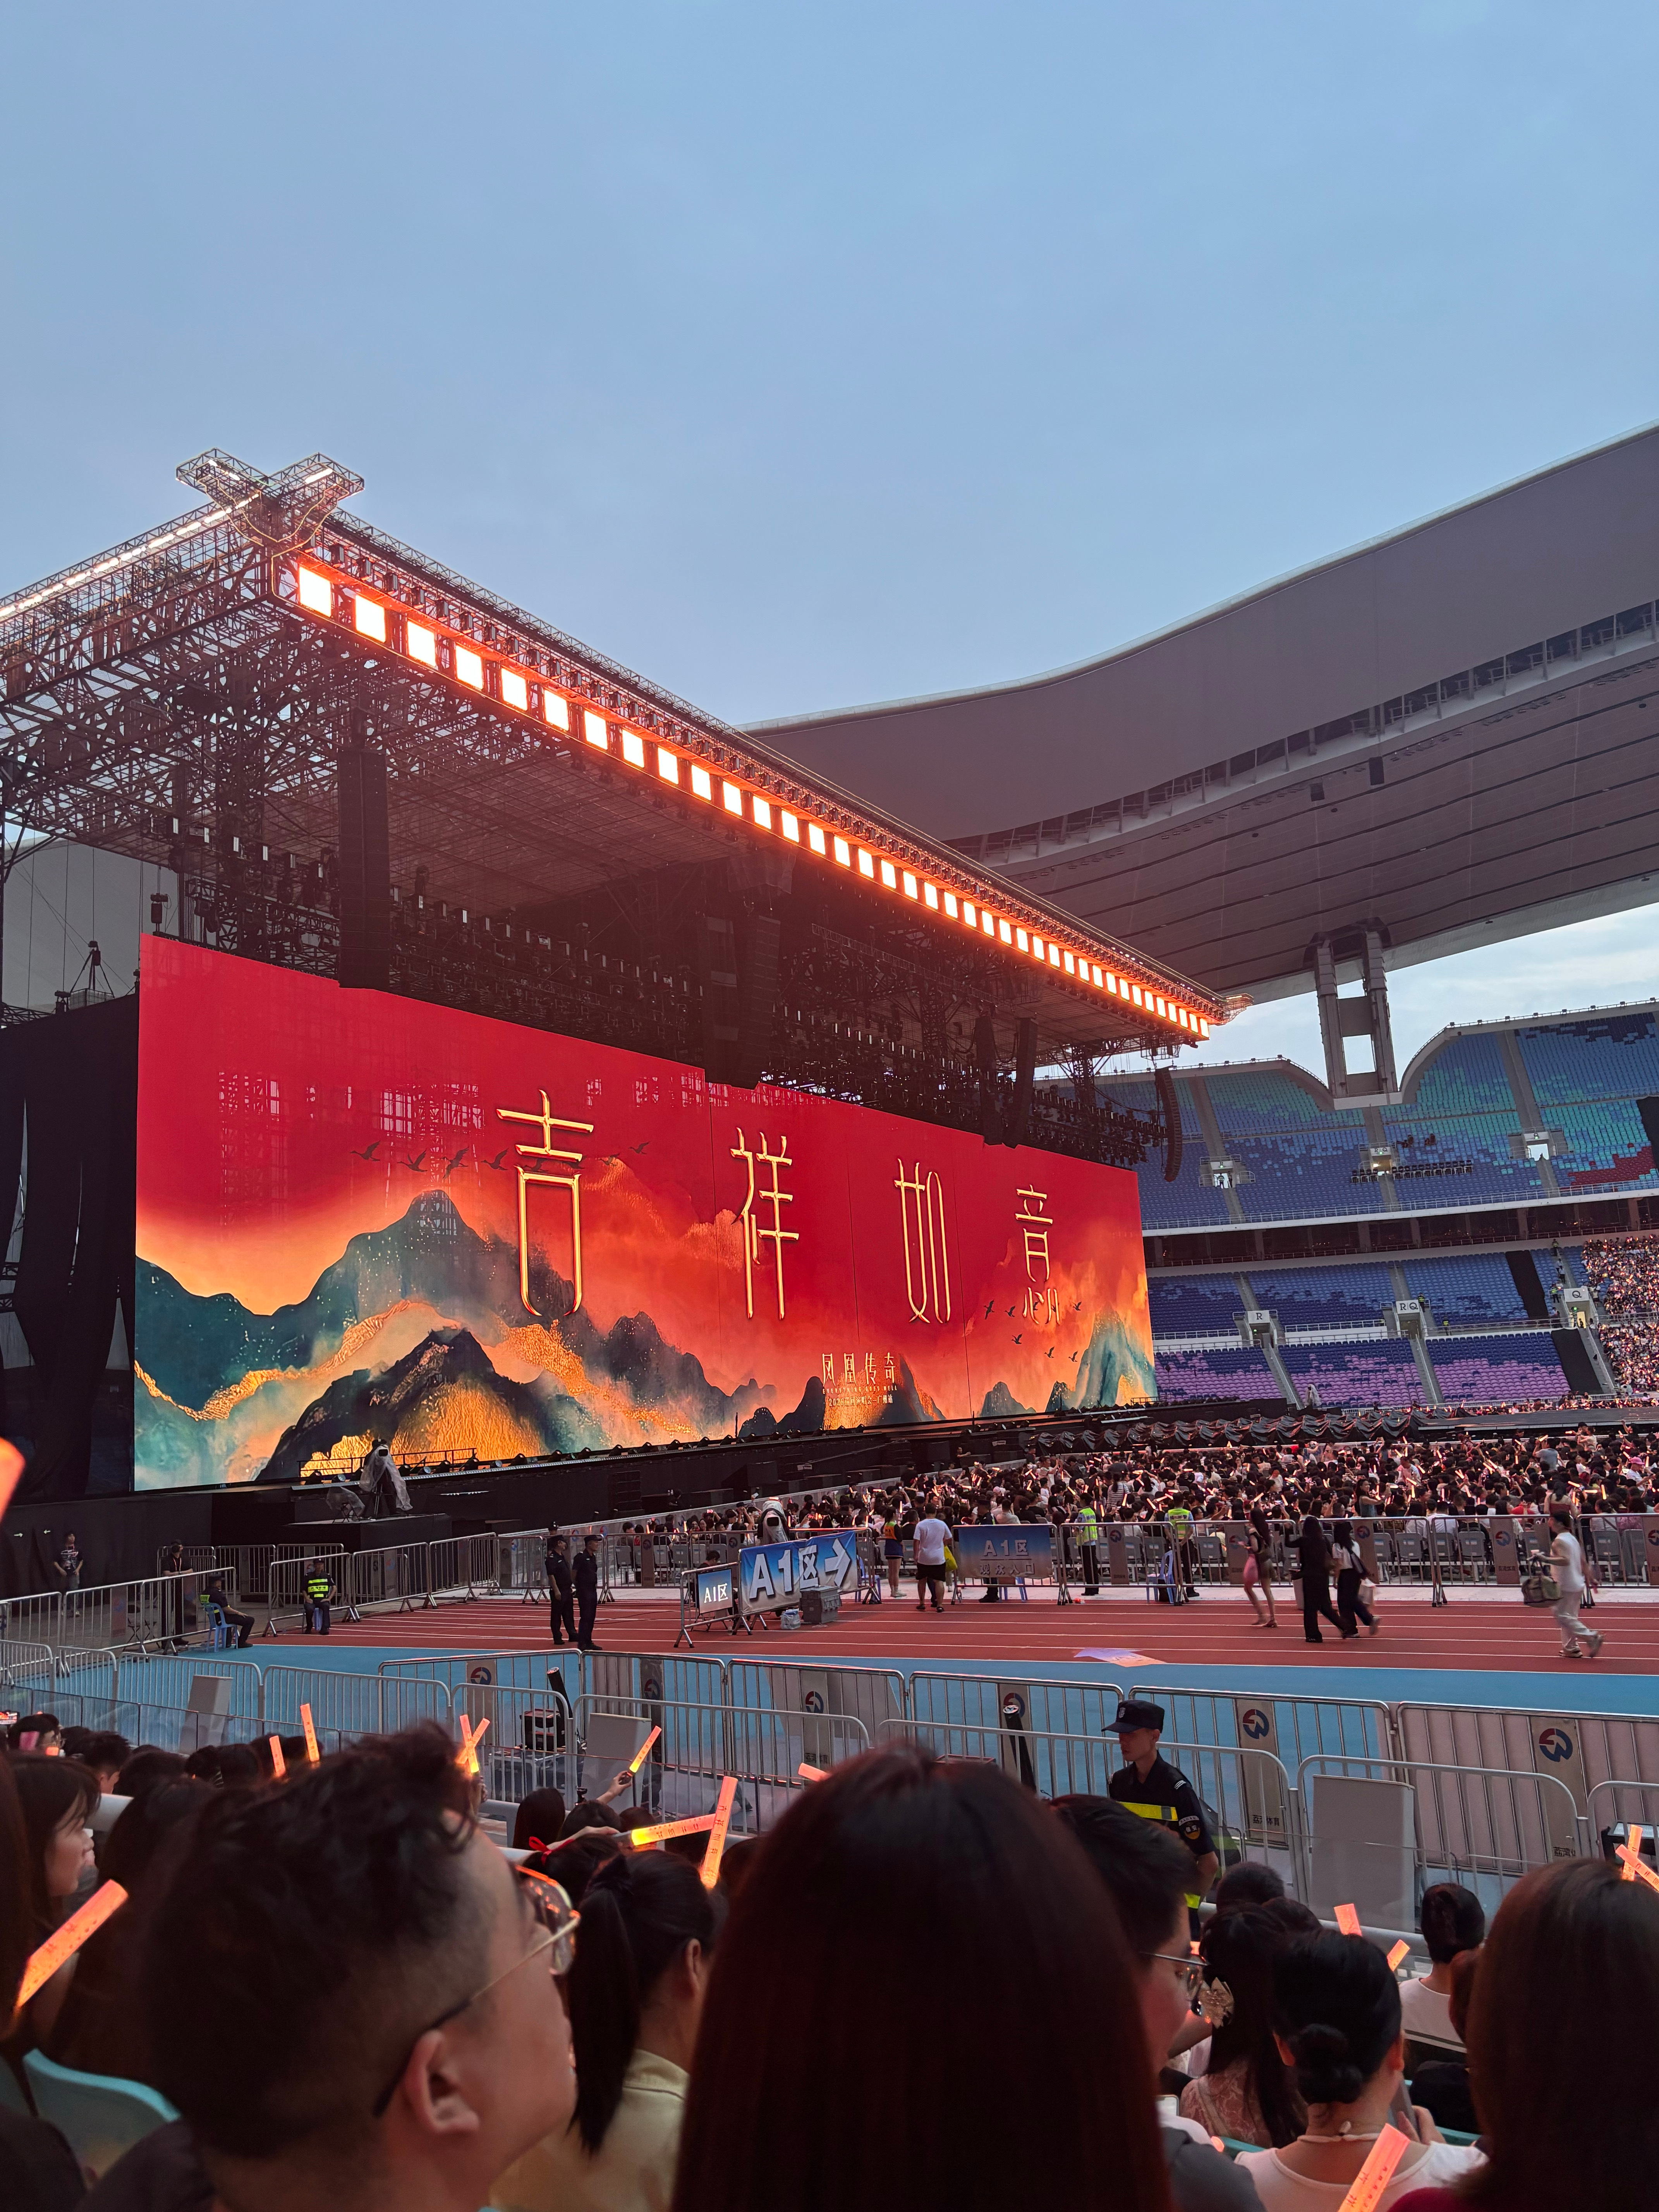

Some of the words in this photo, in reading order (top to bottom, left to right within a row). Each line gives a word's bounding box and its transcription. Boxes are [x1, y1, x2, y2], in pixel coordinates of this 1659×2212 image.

[496, 1089, 1060, 1325] 吉祥如意
[822, 1352, 896, 1387] 凤凰传奇
[823, 1386, 862, 1394] EVERYTHING
[983, 1539, 1029, 1557] A1区
[749, 1545, 819, 1599] A1区
[979, 1563, 1035, 1575] 观众入口
[704, 1583, 728, 1603] A1区
